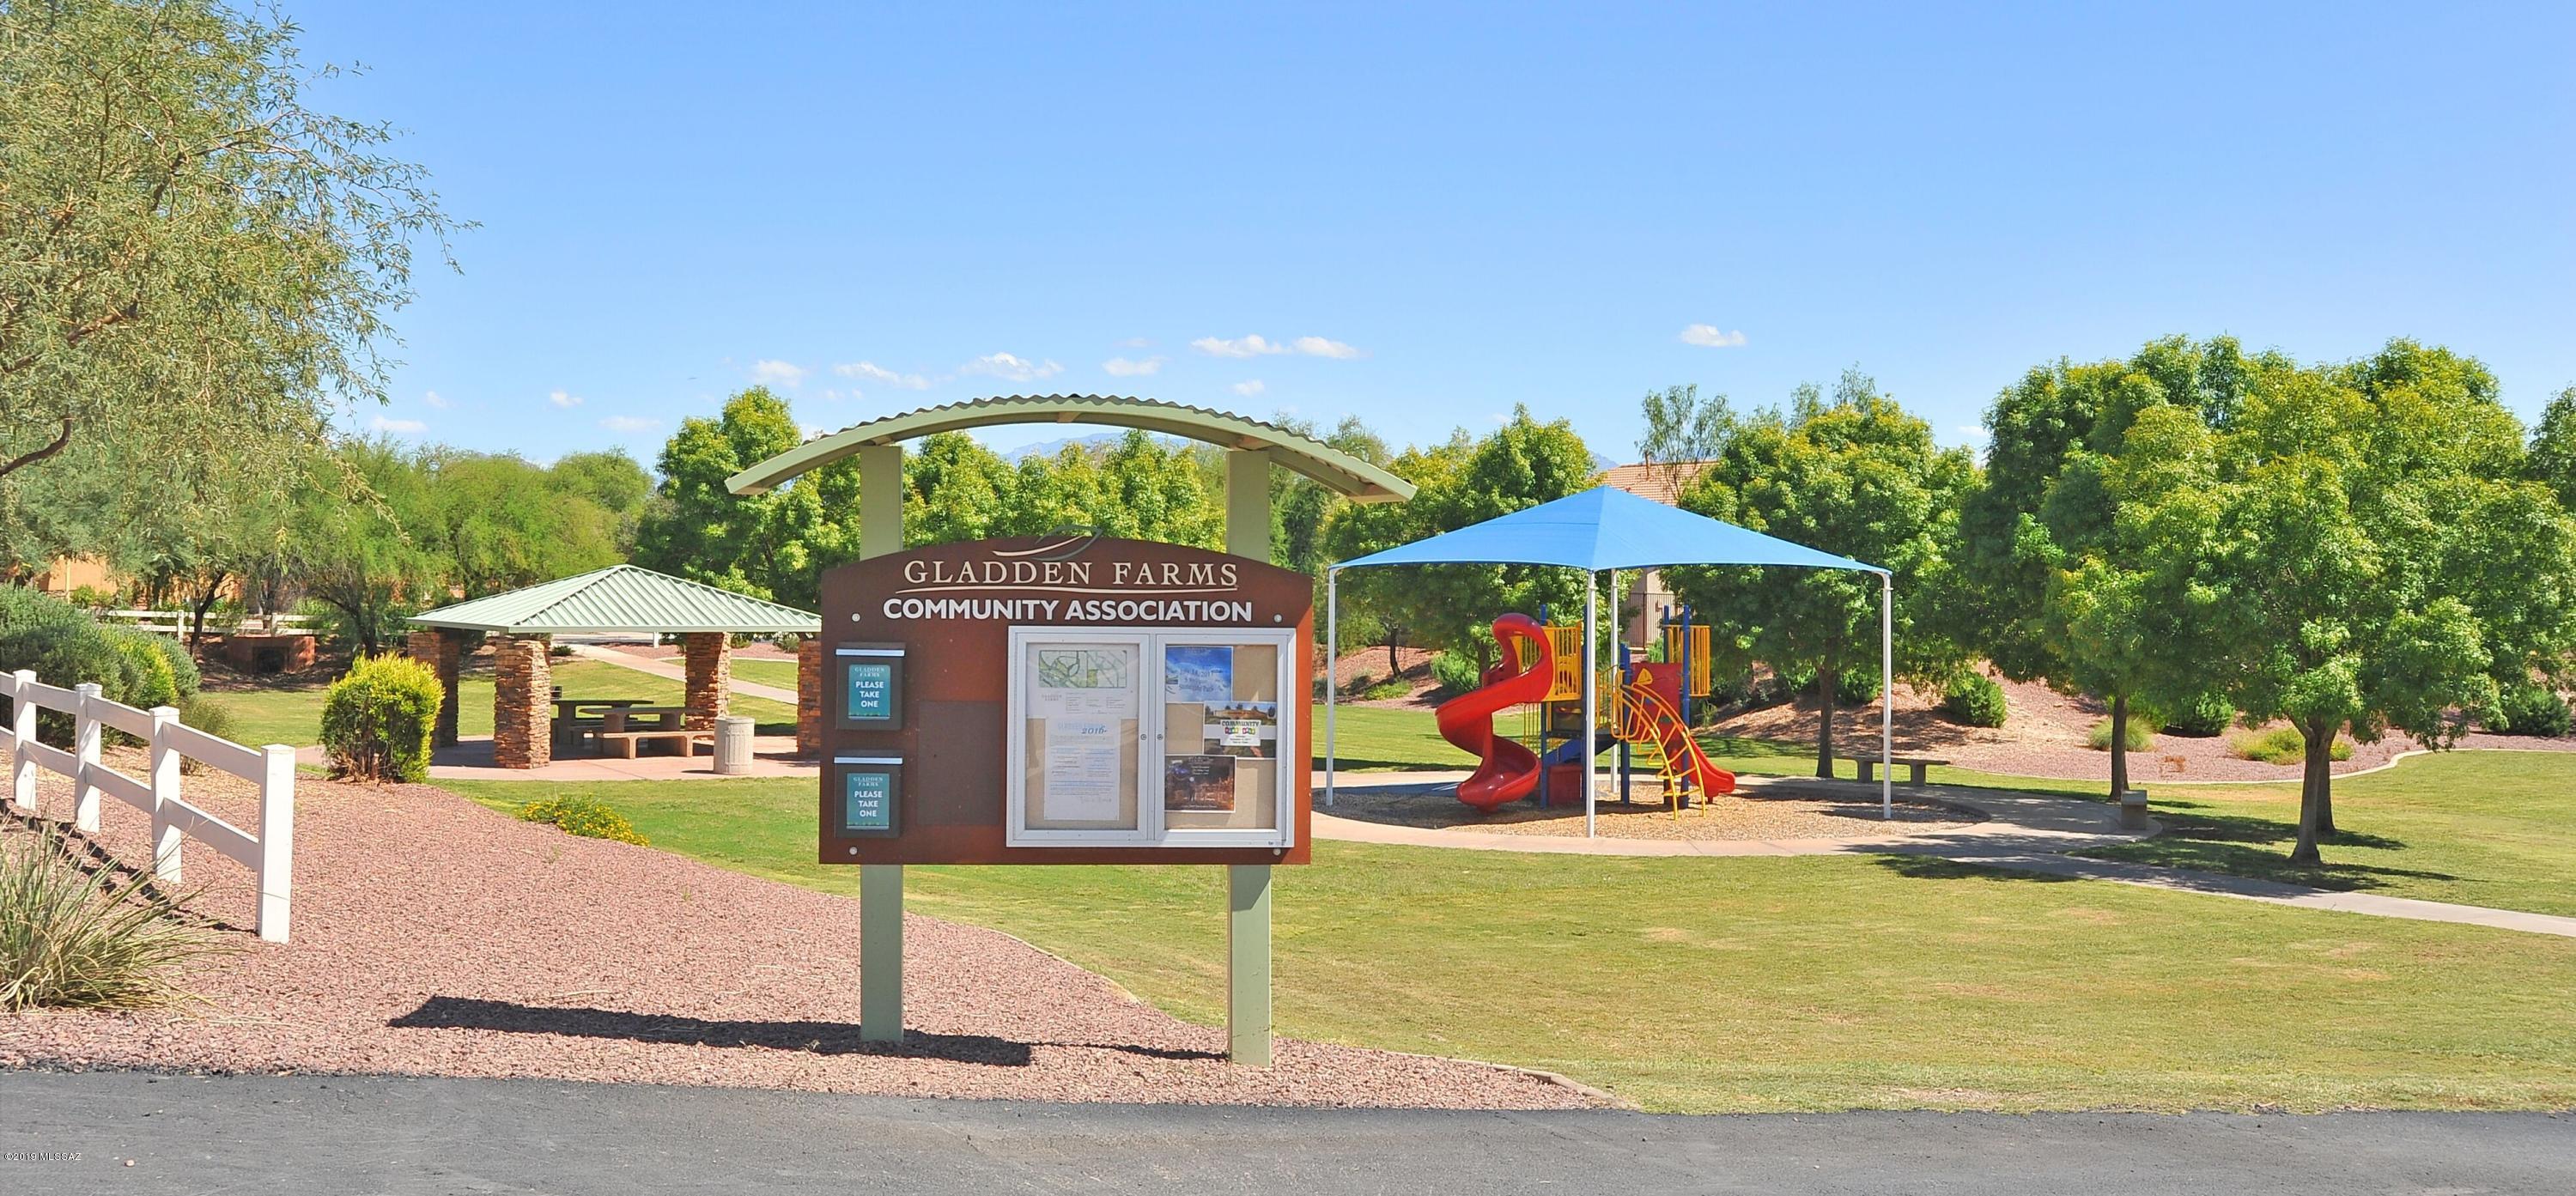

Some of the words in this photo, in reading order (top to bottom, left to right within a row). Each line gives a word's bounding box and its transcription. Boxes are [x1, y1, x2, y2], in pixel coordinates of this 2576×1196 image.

[903, 560, 1093, 586] GLADDEN
[1112, 562, 1238, 586] FARMS
[883, 598, 1060, 621] COMMUNITY
[1065, 599, 1252, 622] ASSOCIATION
